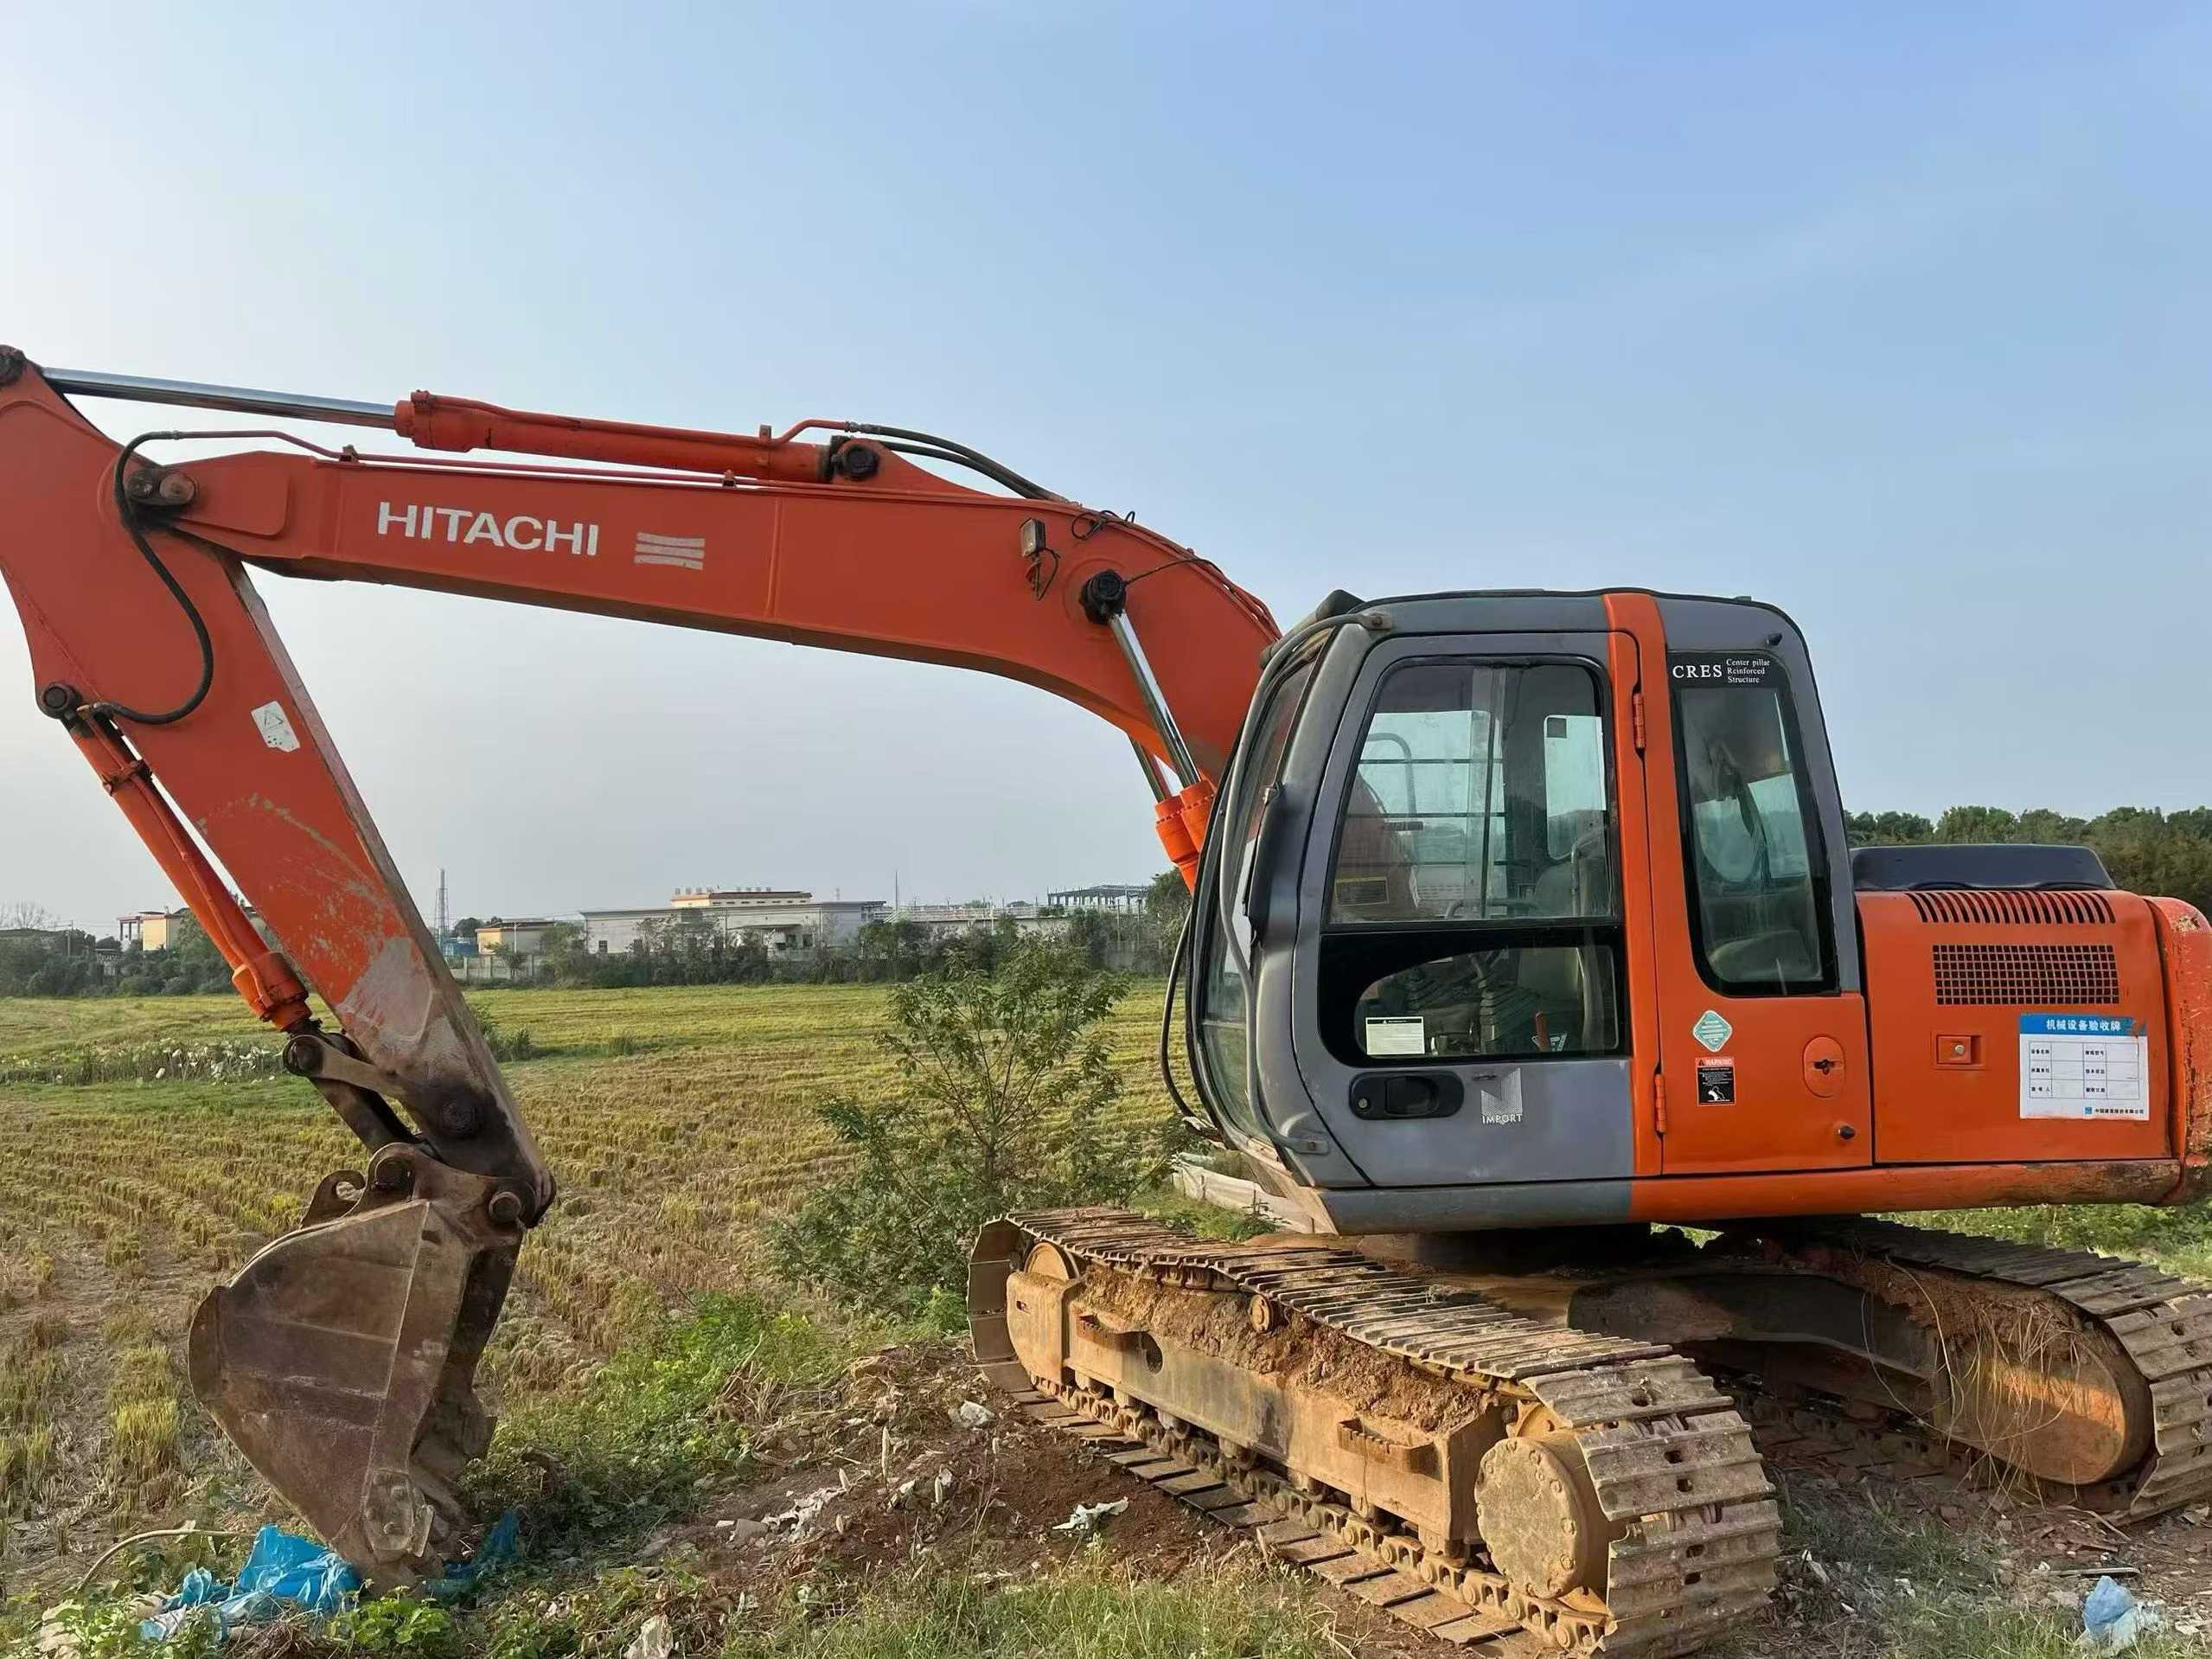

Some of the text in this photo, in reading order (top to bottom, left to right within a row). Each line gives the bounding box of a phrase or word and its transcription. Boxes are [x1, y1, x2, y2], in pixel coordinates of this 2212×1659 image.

[378, 502, 598, 556] HITACHI
[1672, 664, 1723, 678] CRES
[2046, 1019, 2121, 1031] 机械设备验收牌
[1481, 1113, 1523, 1124] IMPORT
